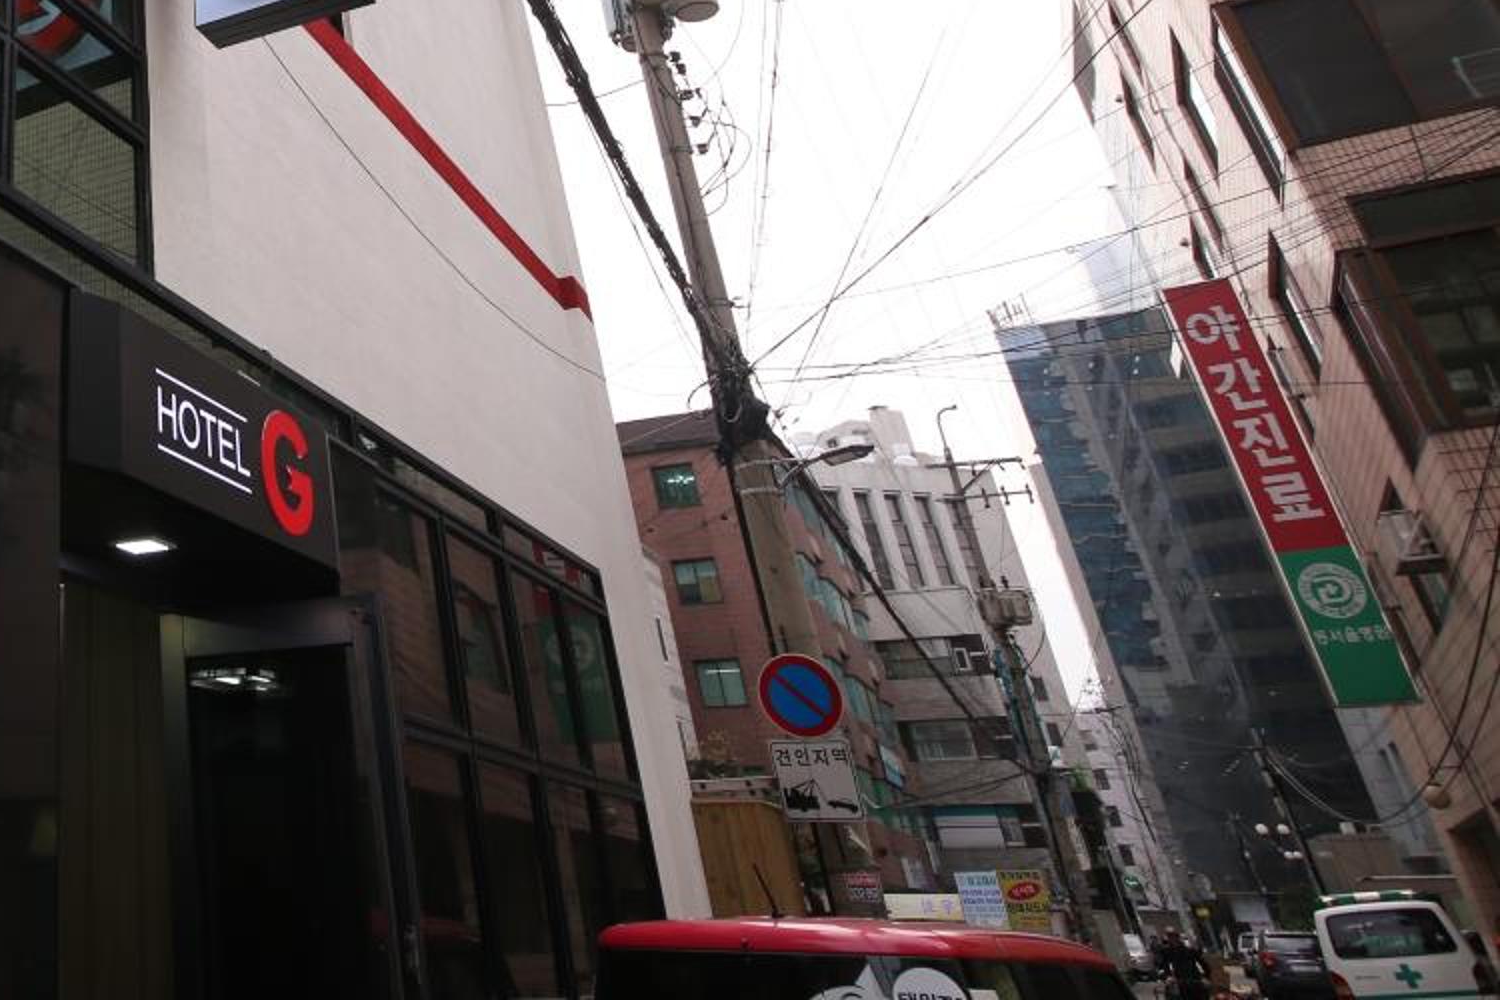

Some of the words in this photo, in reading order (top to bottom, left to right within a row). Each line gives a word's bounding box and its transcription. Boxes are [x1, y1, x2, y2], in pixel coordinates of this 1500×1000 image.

[156, 385, 251, 478] HOTEL
[261, 409, 315, 536] G
[1184, 305, 1327, 523] 야간진료
[775, 748, 849, 767] 견인지역
